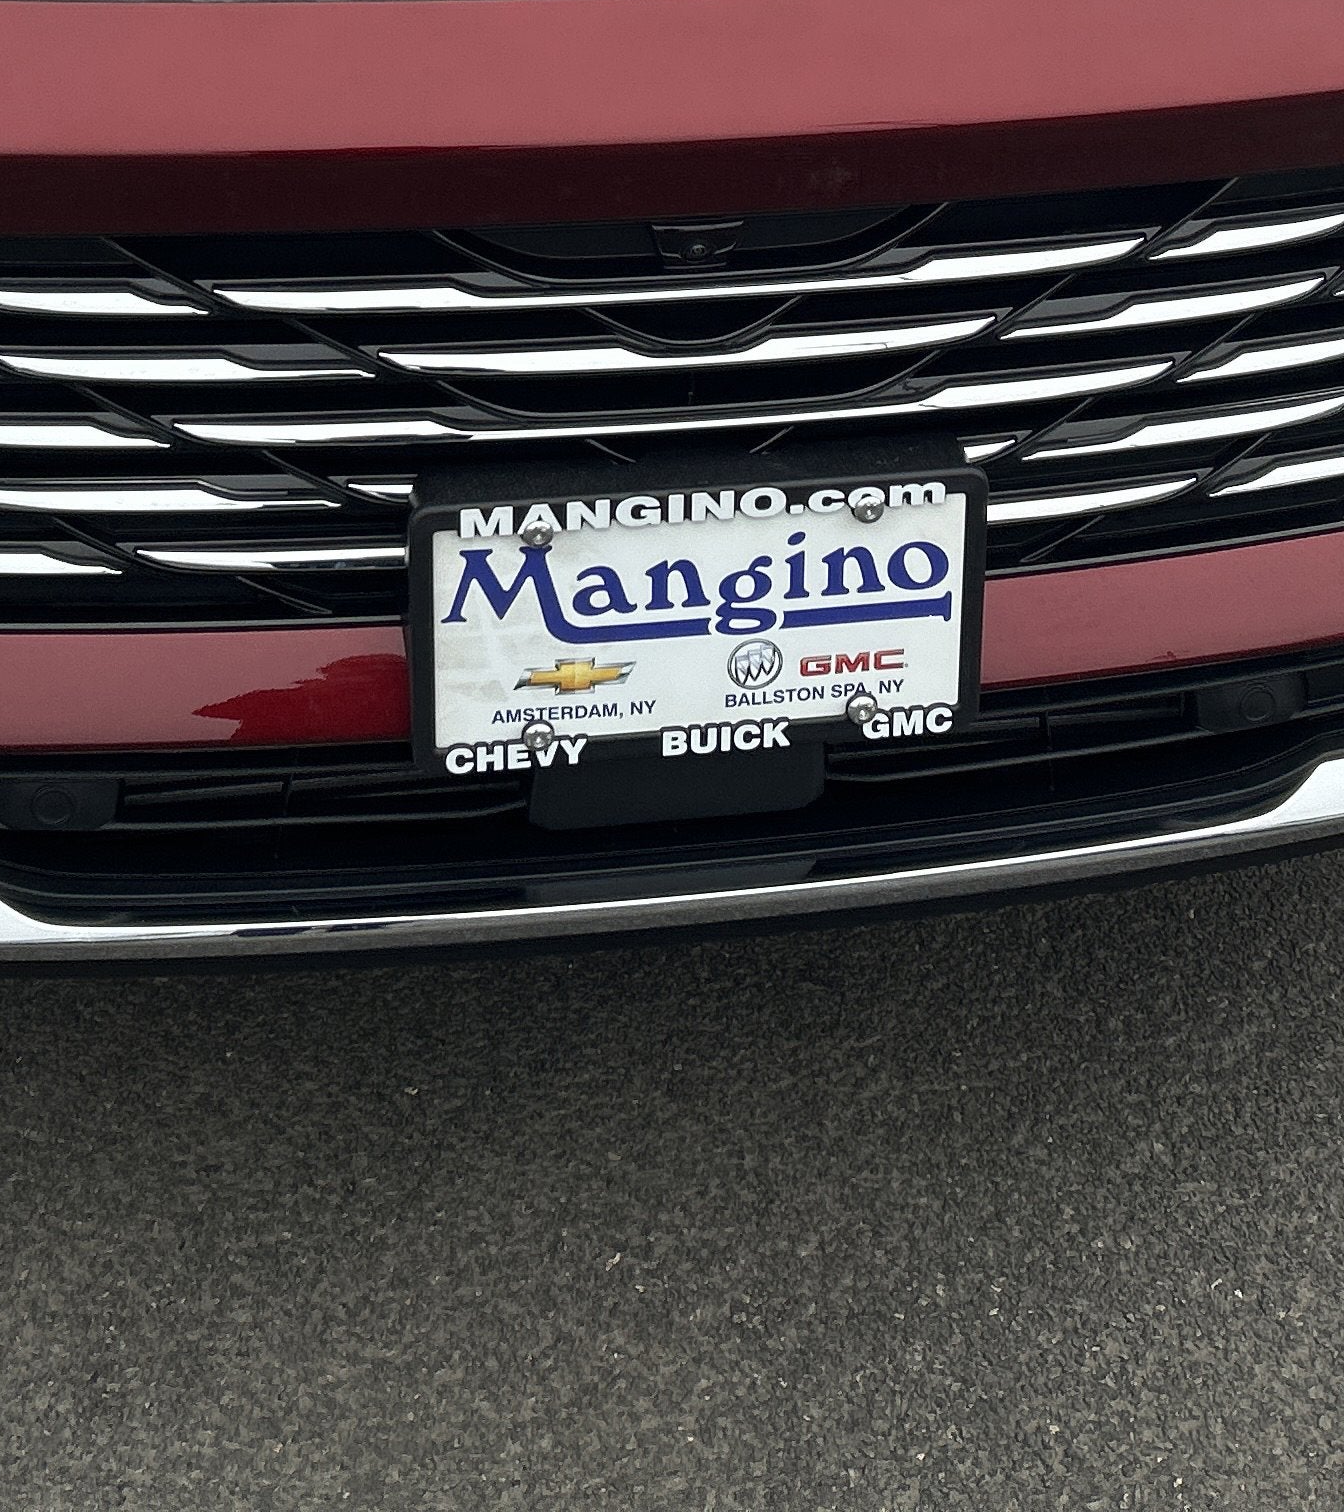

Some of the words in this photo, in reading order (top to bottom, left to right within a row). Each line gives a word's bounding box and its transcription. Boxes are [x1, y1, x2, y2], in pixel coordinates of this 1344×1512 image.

[460, 482, 946, 538] MANGINO.com
[441, 531, 951, 644] Mangino
[799, 648, 906, 677] GMC
[492, 702, 624, 724] AMSTERDAM,
[630, 700, 657, 716] NY
[725, 686, 825, 708] BALLSTON
[879, 679, 905, 694] NY
[445, 737, 588, 775] CHEVY
[662, 720, 791, 757] BUICK
[862, 706, 953, 740] GMC
